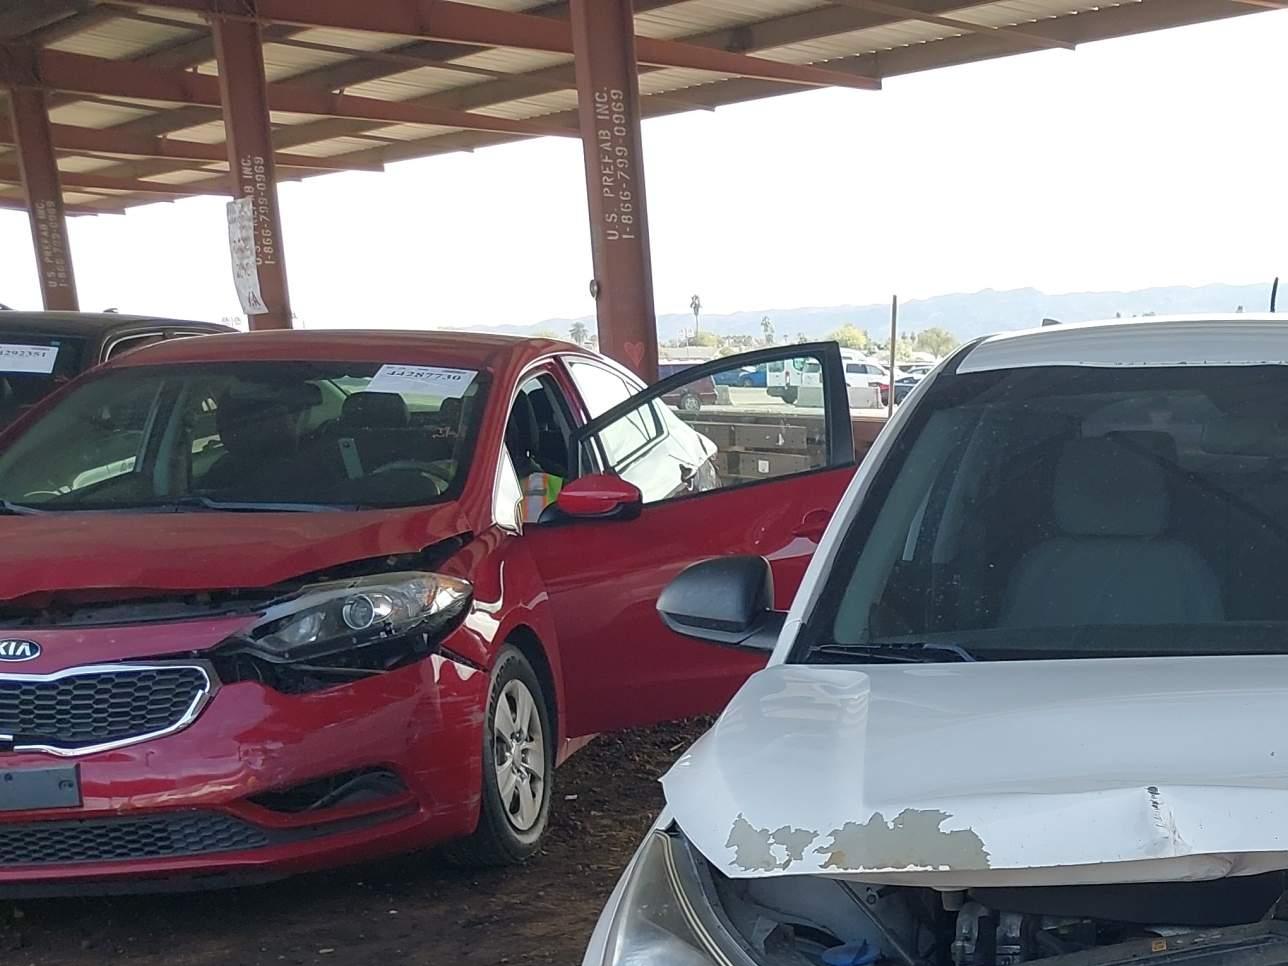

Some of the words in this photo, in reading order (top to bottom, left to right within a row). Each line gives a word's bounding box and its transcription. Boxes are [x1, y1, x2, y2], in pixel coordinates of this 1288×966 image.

[595, 86, 610, 120] INC.
[598, 129, 616, 198] PREFAB
[610, 89, 635, 240] 1-866-799-0969
[605, 209, 620, 240] U.S.
